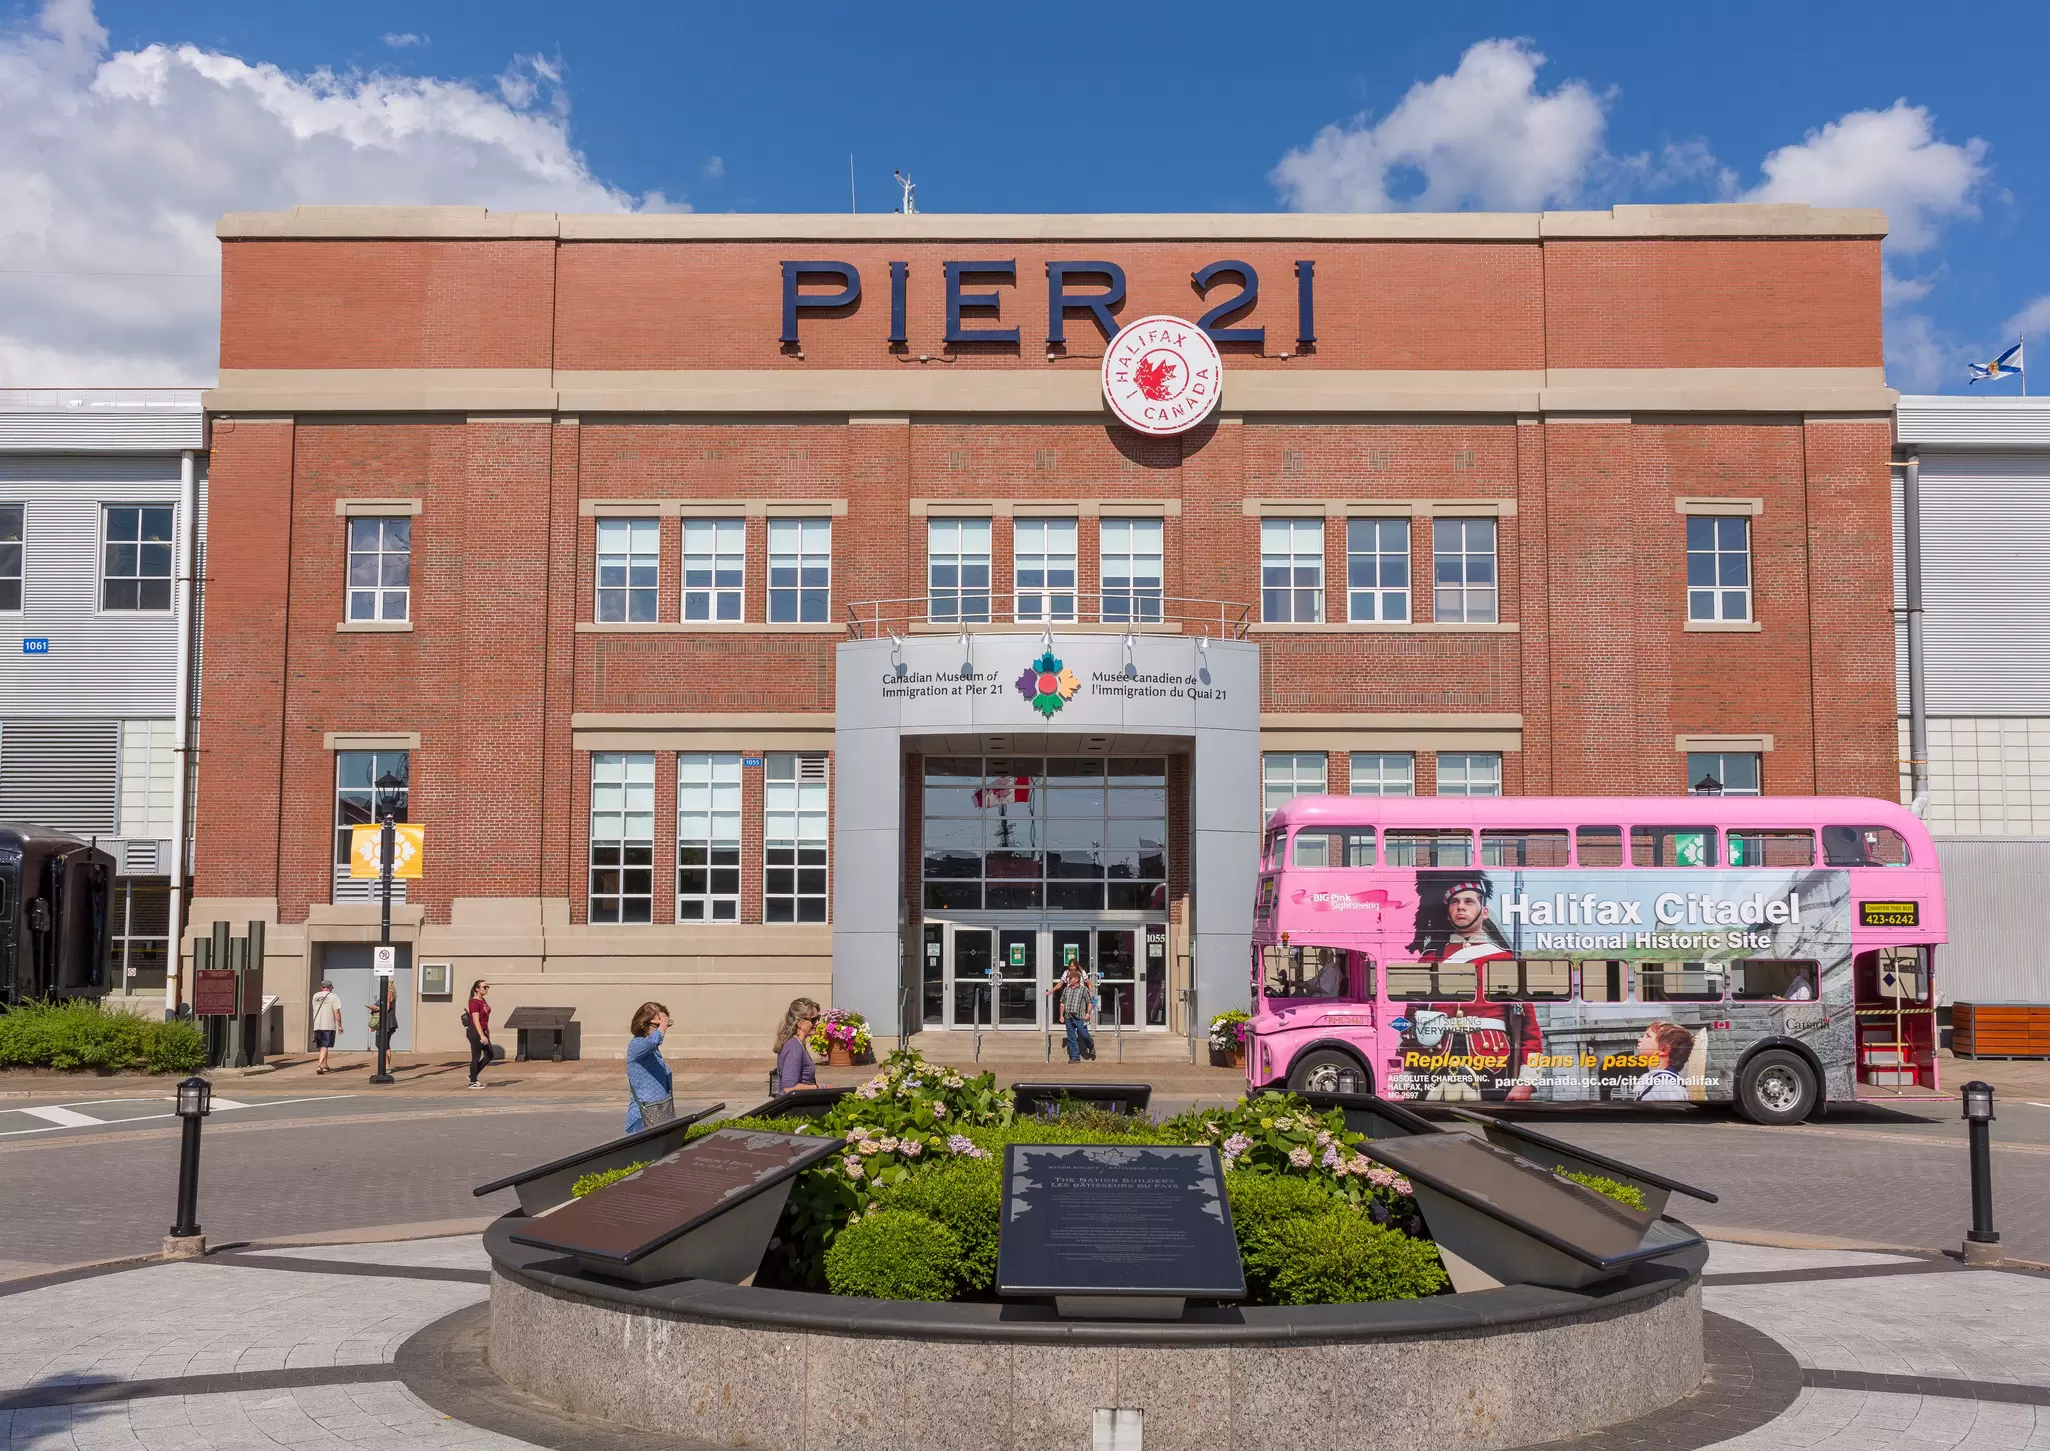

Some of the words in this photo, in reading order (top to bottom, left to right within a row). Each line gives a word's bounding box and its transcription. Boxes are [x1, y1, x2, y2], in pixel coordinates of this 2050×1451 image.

[779, 257, 1126, 345] PIER
[1191, 259, 1317, 343] 21
[1116, 330, 1187, 382] HALIFAX
[1144, 369, 1208, 420] CANADA
[26, 642, 46, 650] 1061
[882, 672, 932, 684] Canadian
[936, 671, 984, 682] Museum
[986, 671, 998, 681] of
[1092, 671, 1130, 682] Musée
[1132, 673, 1182, 684] canadien
[1184, 675, 1196, 685] de
[882, 685, 948, 700] Immigration
[951, 686, 962, 695] at
[966, 684, 987, 694] Pier
[990, 684, 1002, 694] 21
[1092, 684, 1166, 698] l'immigration
[1170, 687, 1184, 697] du
[1187, 688, 1212, 700] Quai
[1215, 690, 1226, 700] 21
[1314, 894, 1329, 902] BIG
[1331, 893, 1351, 902] Pink
[1330, 901, 1380, 911] Sightseeing
[1500, 893, 1644, 925] Halifax
[1655, 892, 1800, 925] Citadel
[1866, 914, 1914, 924] 423-6242
[1146, 934, 1166, 942] 1055
[1536, 931, 1628, 950] National
[1635, 931, 1721, 950] Historic
[1730, 931, 1772, 950] Site
[1411, 1016, 1482, 1026] IGHTSEEING
[1786, 1018, 1830, 1030] Canada
[1404, 1051, 1509, 1071] Replongez
[1527, 1052, 1573, 1068] dans
[1580, 1052, 1597, 1068] le
[1602, 1051, 1660, 1070] passé
[1388, 1074, 1430, 1082] ABSOLUTE
[1431, 1074, 1472, 1082] CHARTERS
[1474, 1074, 1490, 1082] INC.
[1495, 1075, 1720, 1088] parcscanada.gc.ca/citadellehalifax
[1388, 1084, 1423, 1092] HALIFAX,
